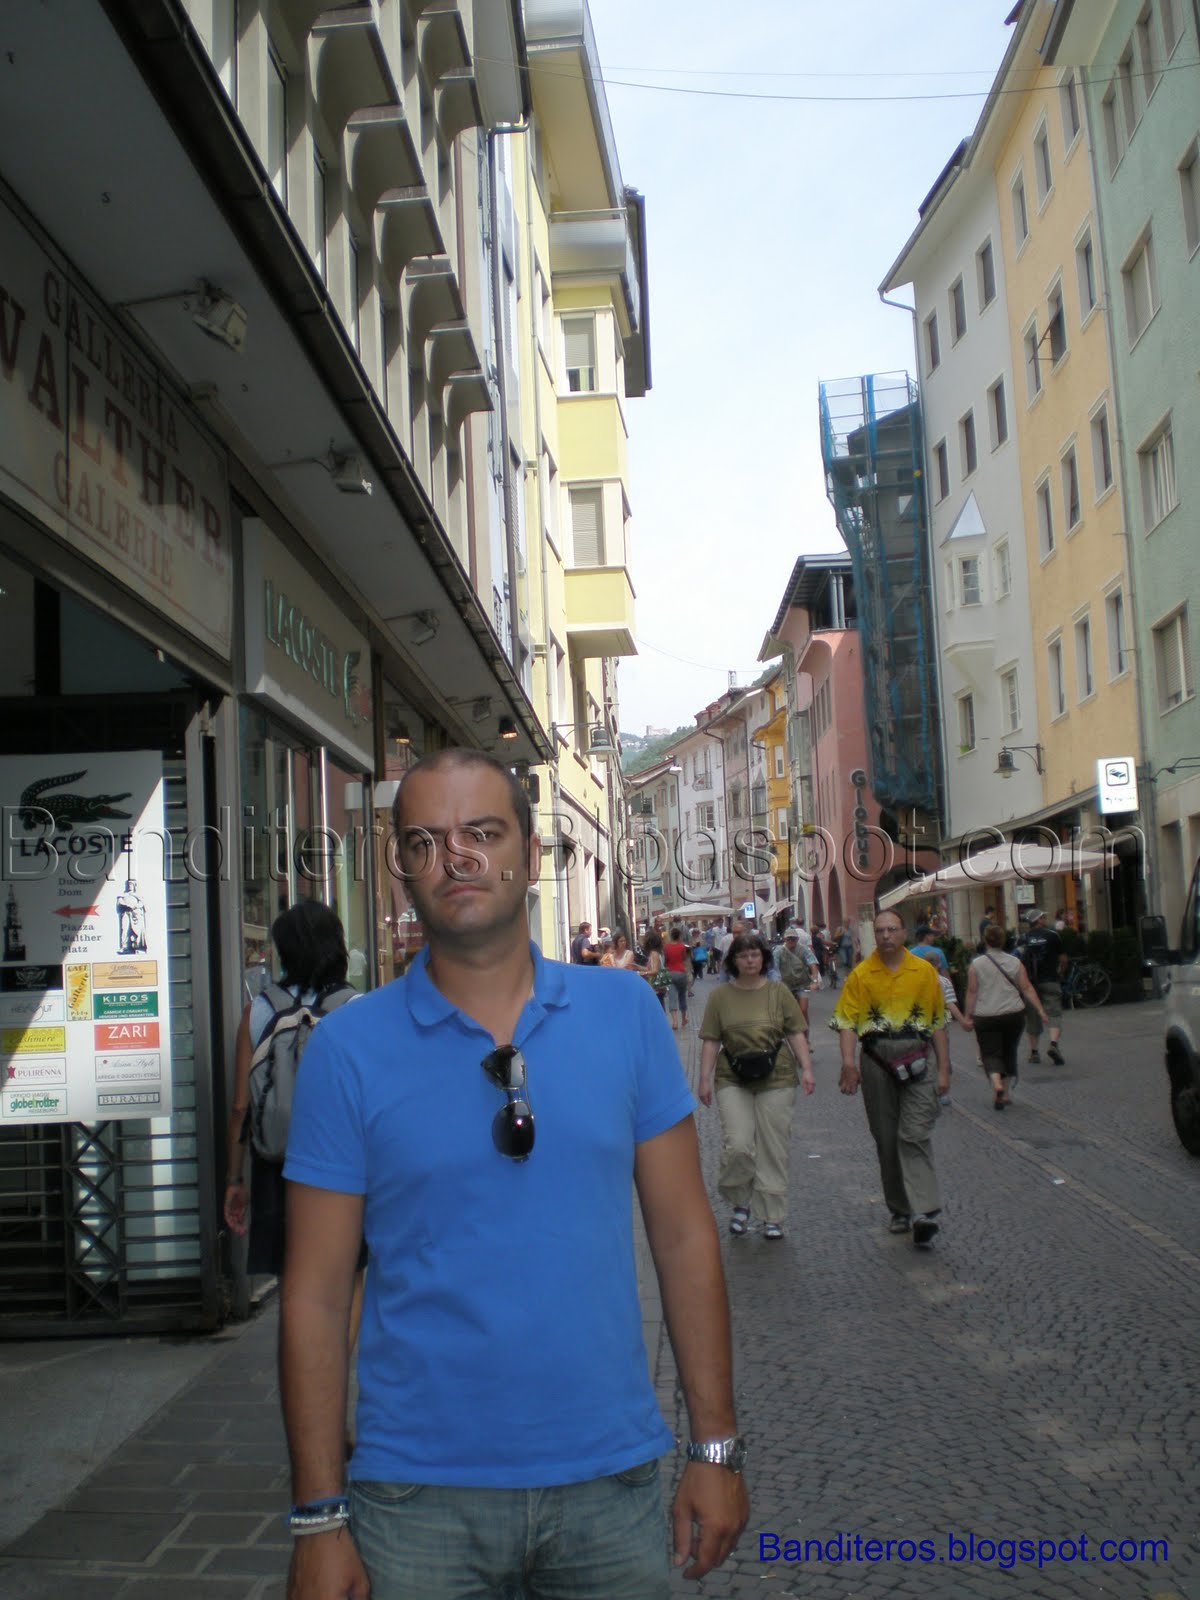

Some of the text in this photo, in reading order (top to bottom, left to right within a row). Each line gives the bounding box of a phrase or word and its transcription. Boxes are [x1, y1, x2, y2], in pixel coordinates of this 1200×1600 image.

[44, 269, 179, 453] GALLERIA
[53, 449, 174, 588] GALERIE
[264, 578, 337, 697] LACOSTE
[20, 833, 133, 857] LACOSTE
[58, 888, 82, 897] Dom
[60, 923, 95, 932] Piazza
[60, 934, 102, 943] Walther
[61, 945, 88, 953] Platz
[108, 1025, 147, 1039] ZARI
[10, 1096, 59, 1113] globetrotter
[102, 1094, 157, 1104] BURATTI
